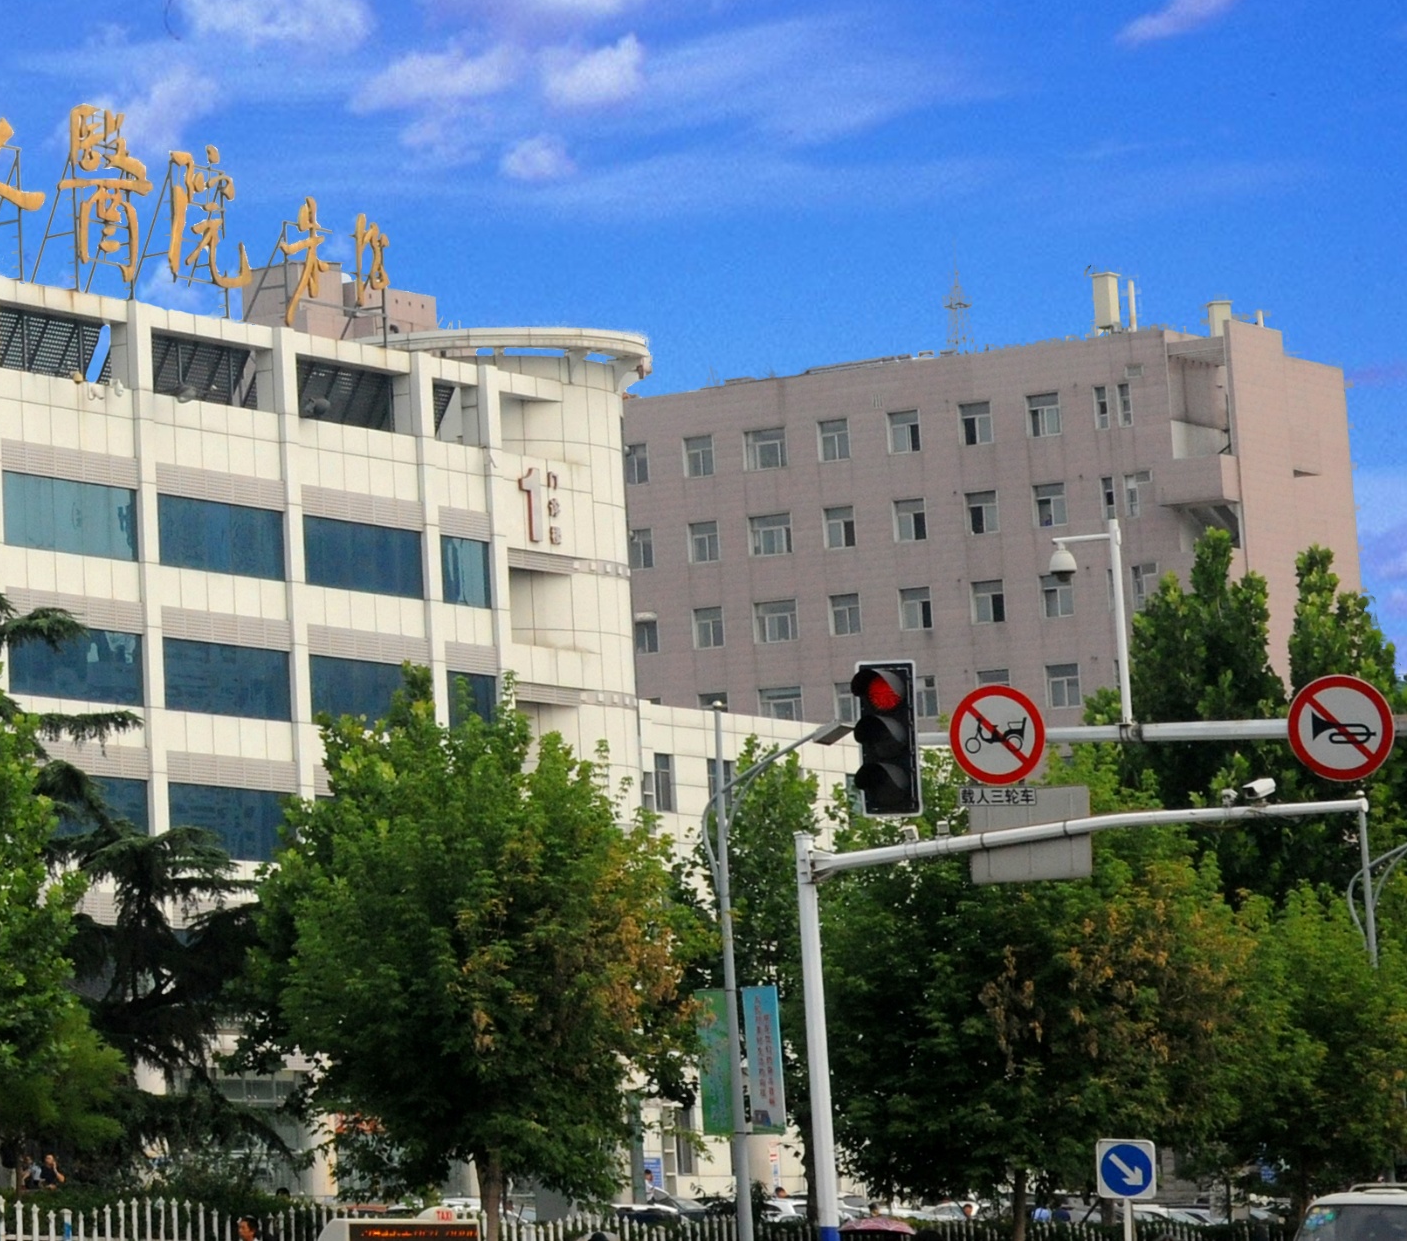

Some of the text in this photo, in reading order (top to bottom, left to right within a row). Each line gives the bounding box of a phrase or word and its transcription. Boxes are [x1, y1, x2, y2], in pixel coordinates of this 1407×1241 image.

[517, 466, 544, 543] 1
[961, 788, 1035, 805] 载人三轮车
[436, 1210, 453, 1222] TAXI
